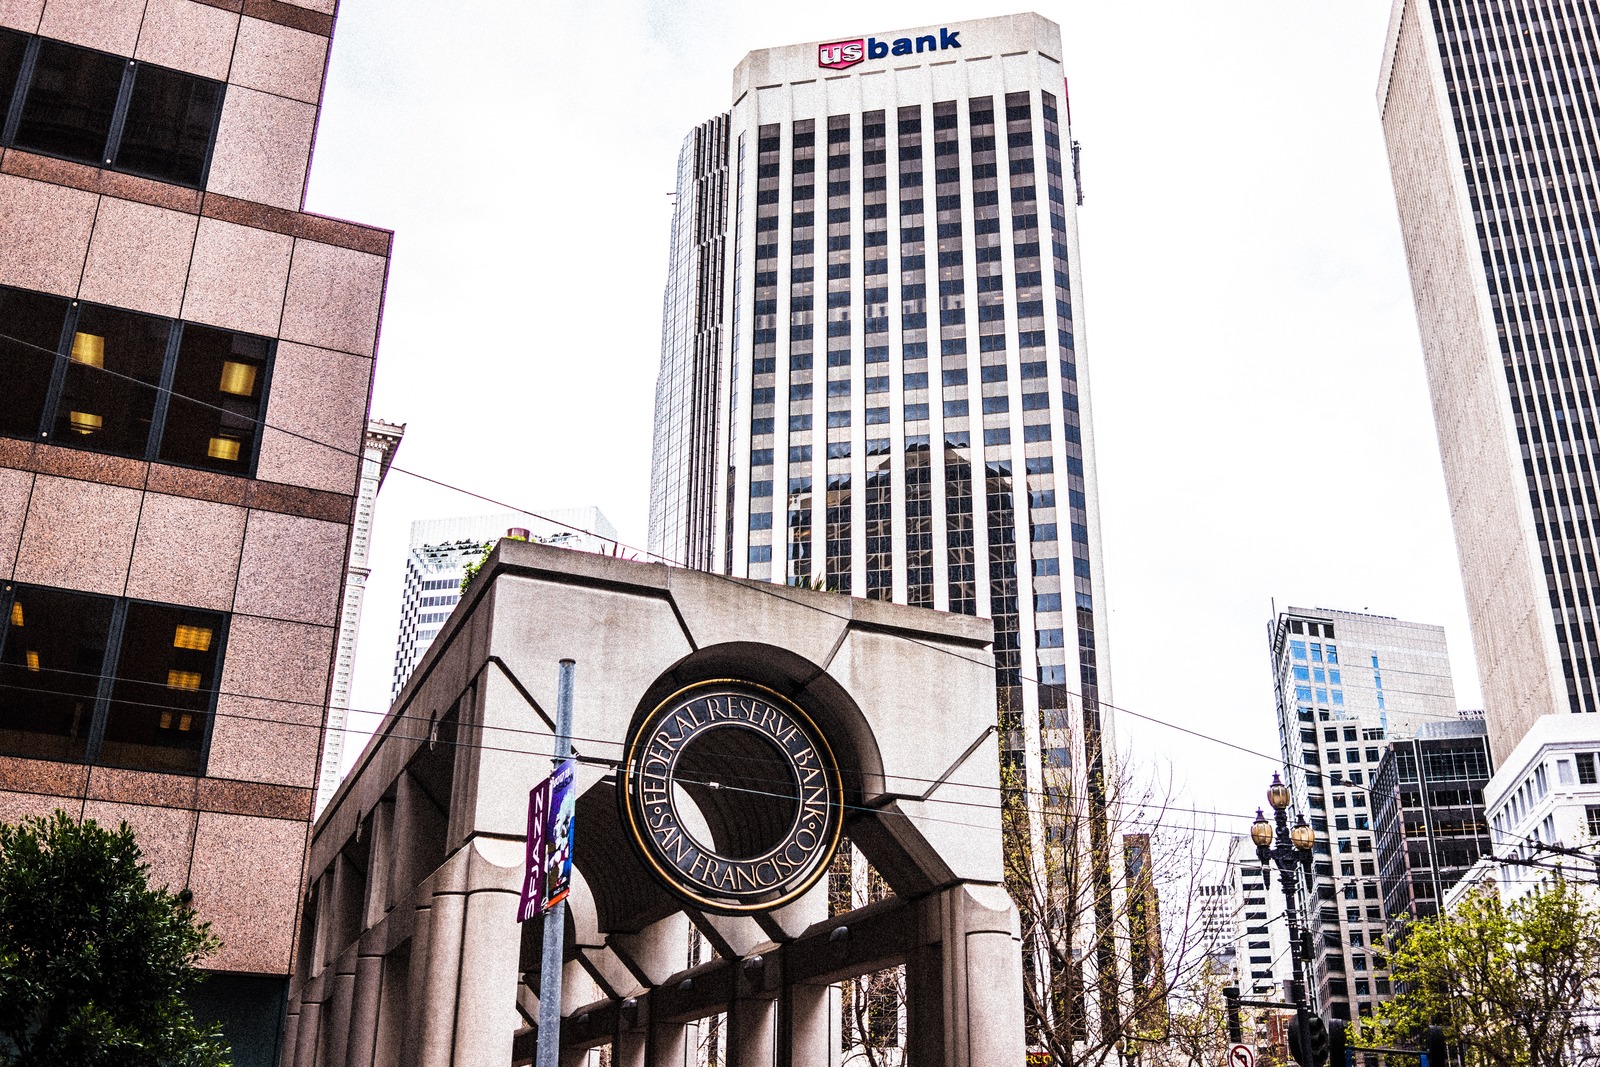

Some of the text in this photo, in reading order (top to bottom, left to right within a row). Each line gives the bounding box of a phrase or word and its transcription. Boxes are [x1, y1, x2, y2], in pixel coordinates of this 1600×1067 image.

[821, 28, 961, 64] us bank
[644, 697, 826, 825] FEDERAL RESERVE BANK
[525, 787, 544, 920] SFJAZZ
[650, 813, 817, 890] SAN FRANCISCO
